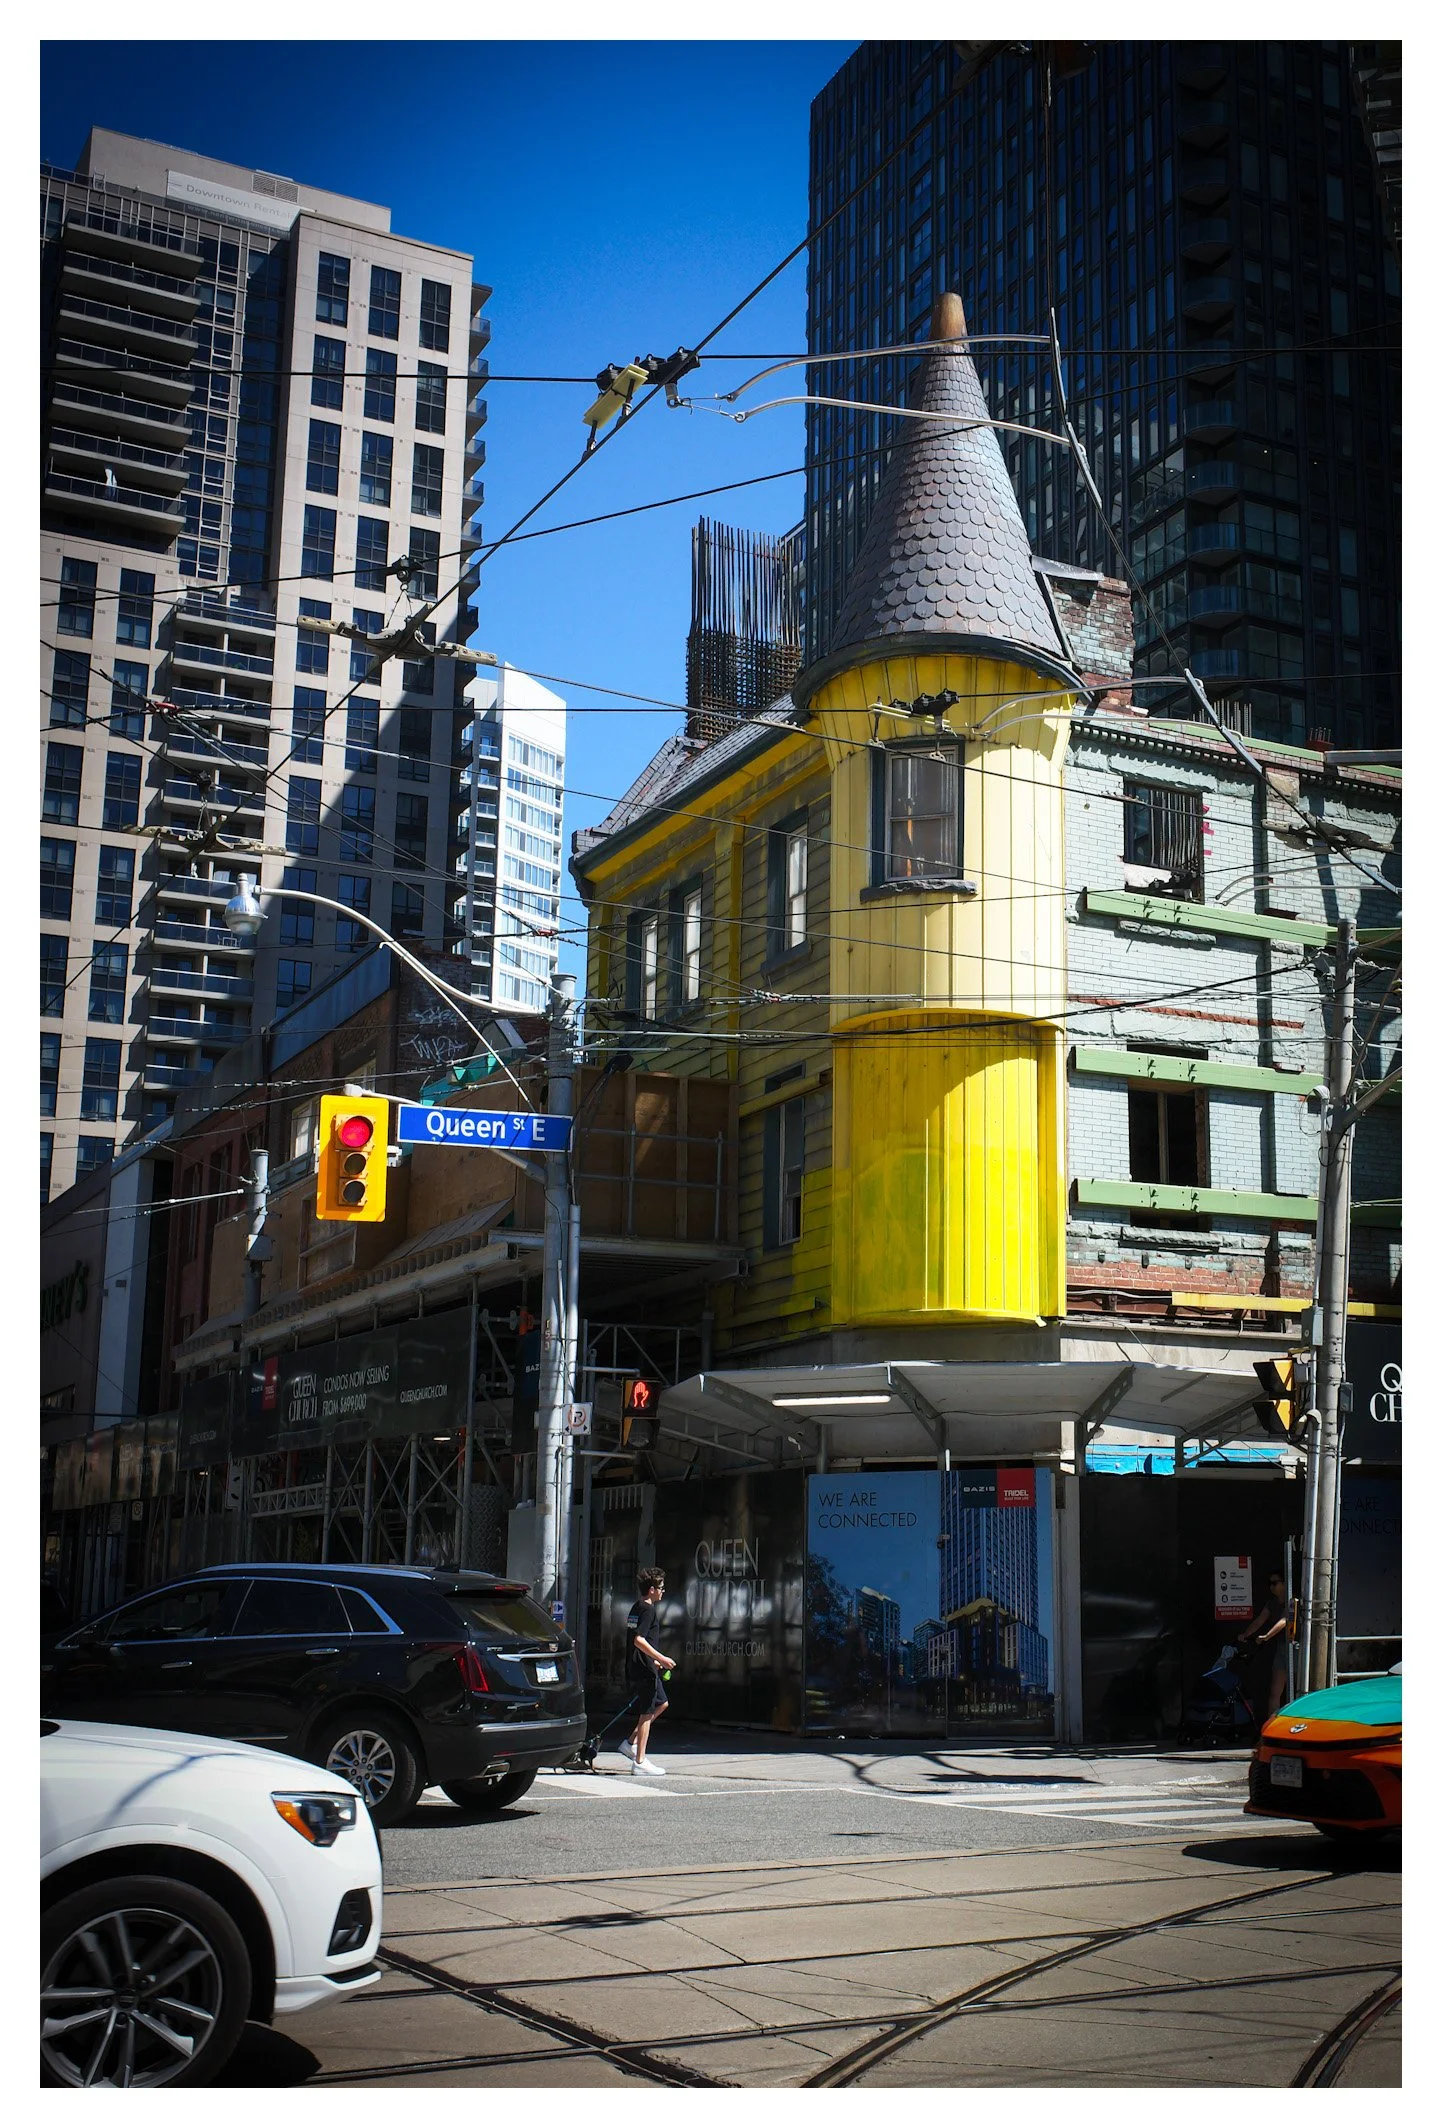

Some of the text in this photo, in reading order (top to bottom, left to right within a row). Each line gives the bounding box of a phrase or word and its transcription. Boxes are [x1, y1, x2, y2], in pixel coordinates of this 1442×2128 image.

[186, 184, 251, 209] Downtown
[426, 1111, 546, 1141] Queen St E
[293, 1373, 317, 1399] QUEEN
[323, 1364, 390, 1394] CONDOS NOW SELLING
[322, 1399, 338, 1416] FROM
[819, 1492, 877, 1507] WE ARE
[818, 1512, 917, 1529] CONNECTED
[695, 1537, 759, 1578] QUEEN
[685, 1640, 765, 1656] QUEENCHURCH.COM
